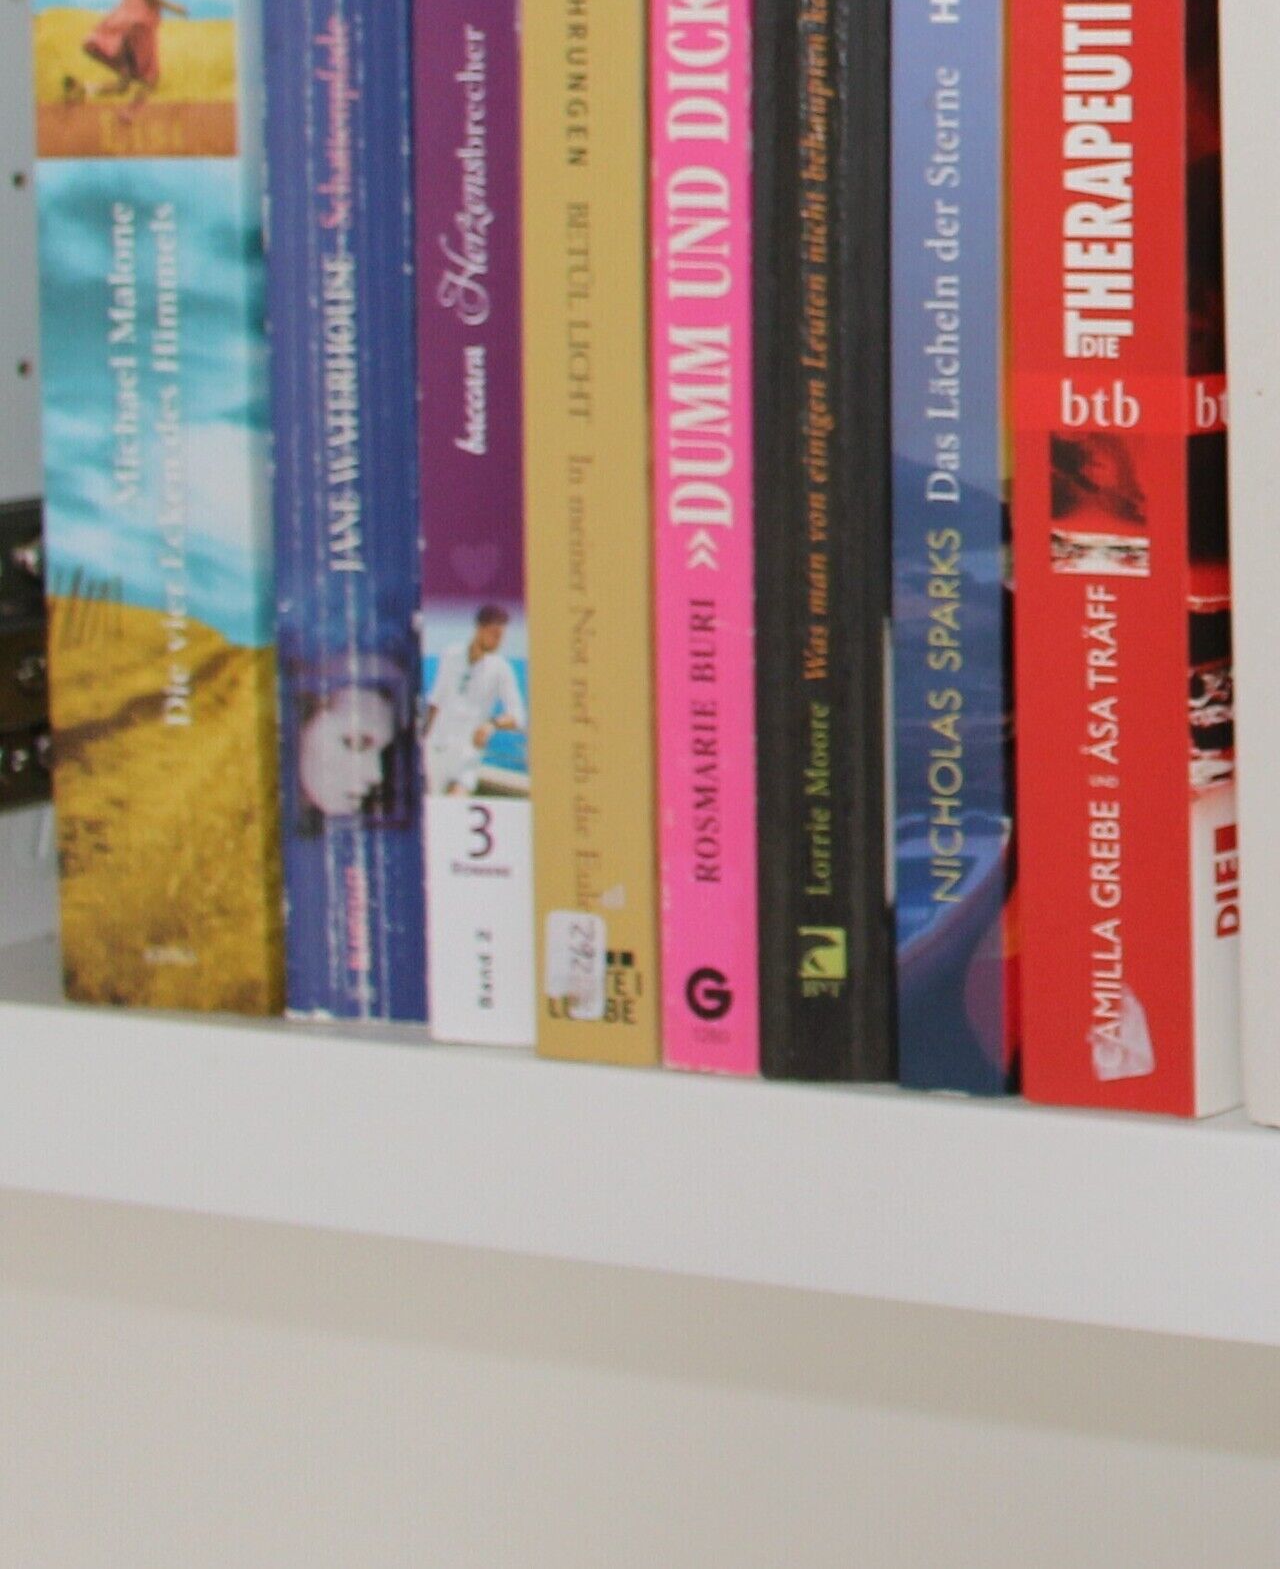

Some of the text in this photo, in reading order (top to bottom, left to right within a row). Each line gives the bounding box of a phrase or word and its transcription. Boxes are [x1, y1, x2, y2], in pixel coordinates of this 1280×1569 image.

[800, 33, 836, 181] behaupten
[437, 23, 495, 326] Herzensbrecher
[666, 164, 732, 300] UND
[800, 192, 828, 263] nicht
[148, 202, 181, 374] Himmels
[800, 274, 829, 369] Leuten
[923, 65, 962, 503] Das Lächeln der Sterne
[104, 202, 143, 505] Michael Malone
[1081, 336, 1120, 359] DIE
[320, 252, 365, 572] JANE WATERHOUSE
[802, 379, 836, 483] einigen
[1061, 377, 1141, 429] btb
[1195, 380, 1228, 429] bt
[804, 492, 829, 543] von
[162, 583, 191, 652] vier
[804, 553, 829, 615] man
[800, 624, 830, 680] Was
[1081, 583, 1119, 690] TRÄFF
[162, 663, 192, 727] Die
[687, 597, 721, 884] ROSMARIE BURI
[924, 528, 964, 903] NICHOLAS SPARKS
[1080, 695, 1119, 765] ÅSA
[468, 805, 494, 859] 3
[803, 700, 833, 896] Lorrie Moore
[1088, 801, 1122, 909] GREBE
[1214, 856, 1241, 939] DIE
[685, 967, 734, 1021] G
